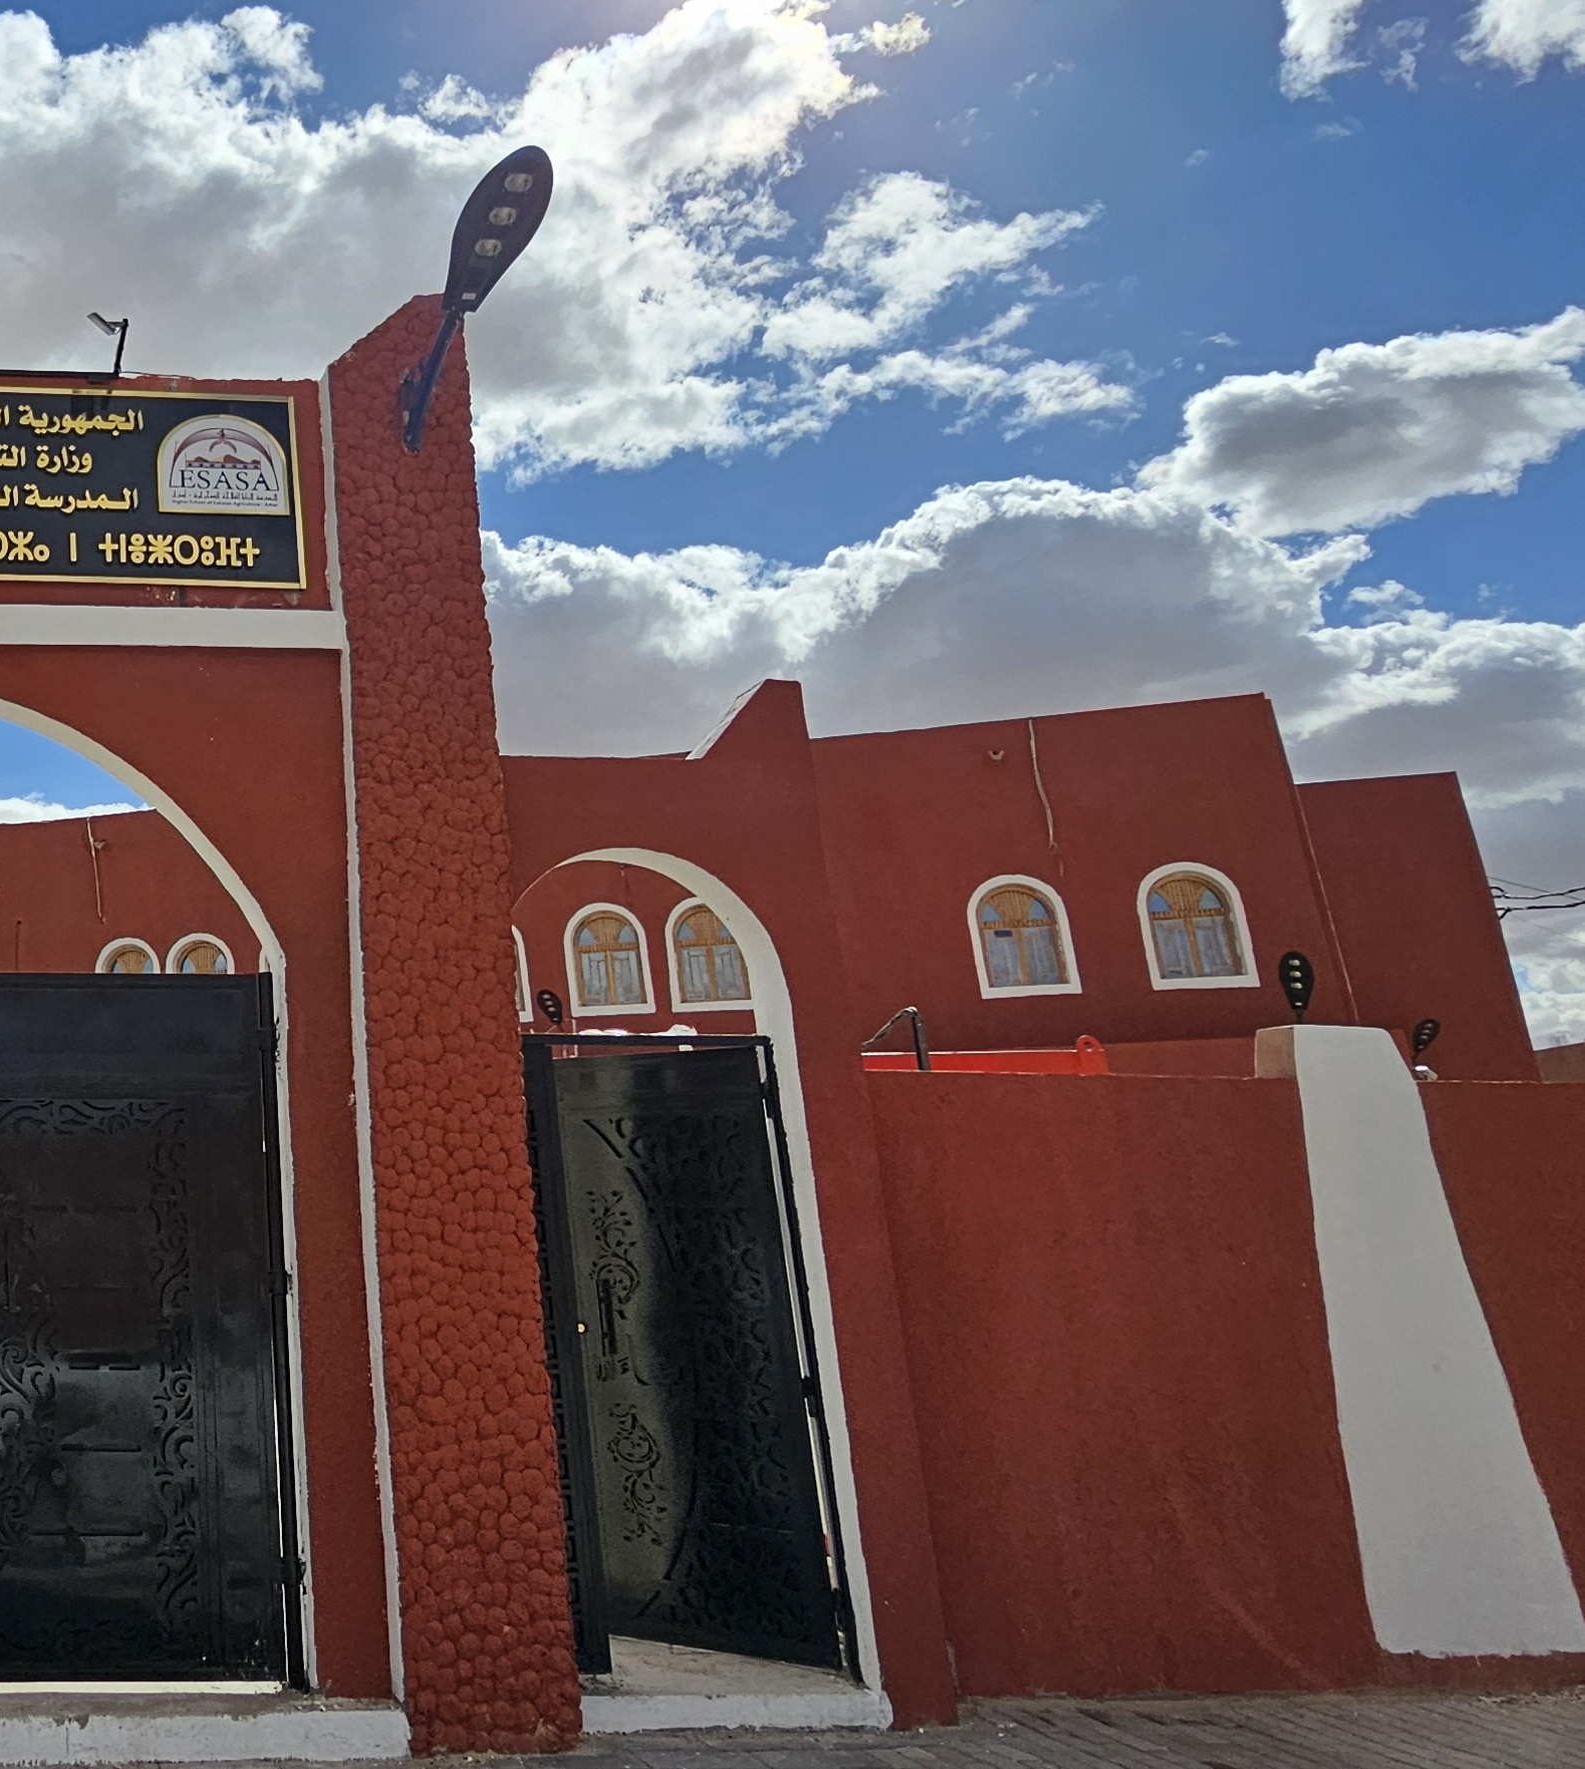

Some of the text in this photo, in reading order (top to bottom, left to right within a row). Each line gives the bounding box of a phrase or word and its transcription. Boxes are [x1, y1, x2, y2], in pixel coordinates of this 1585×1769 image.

[18, 404, 144, 436] الجمهورية
[36, 444, 93, 473] وزارة
[178, 469, 271, 491] ESASA
